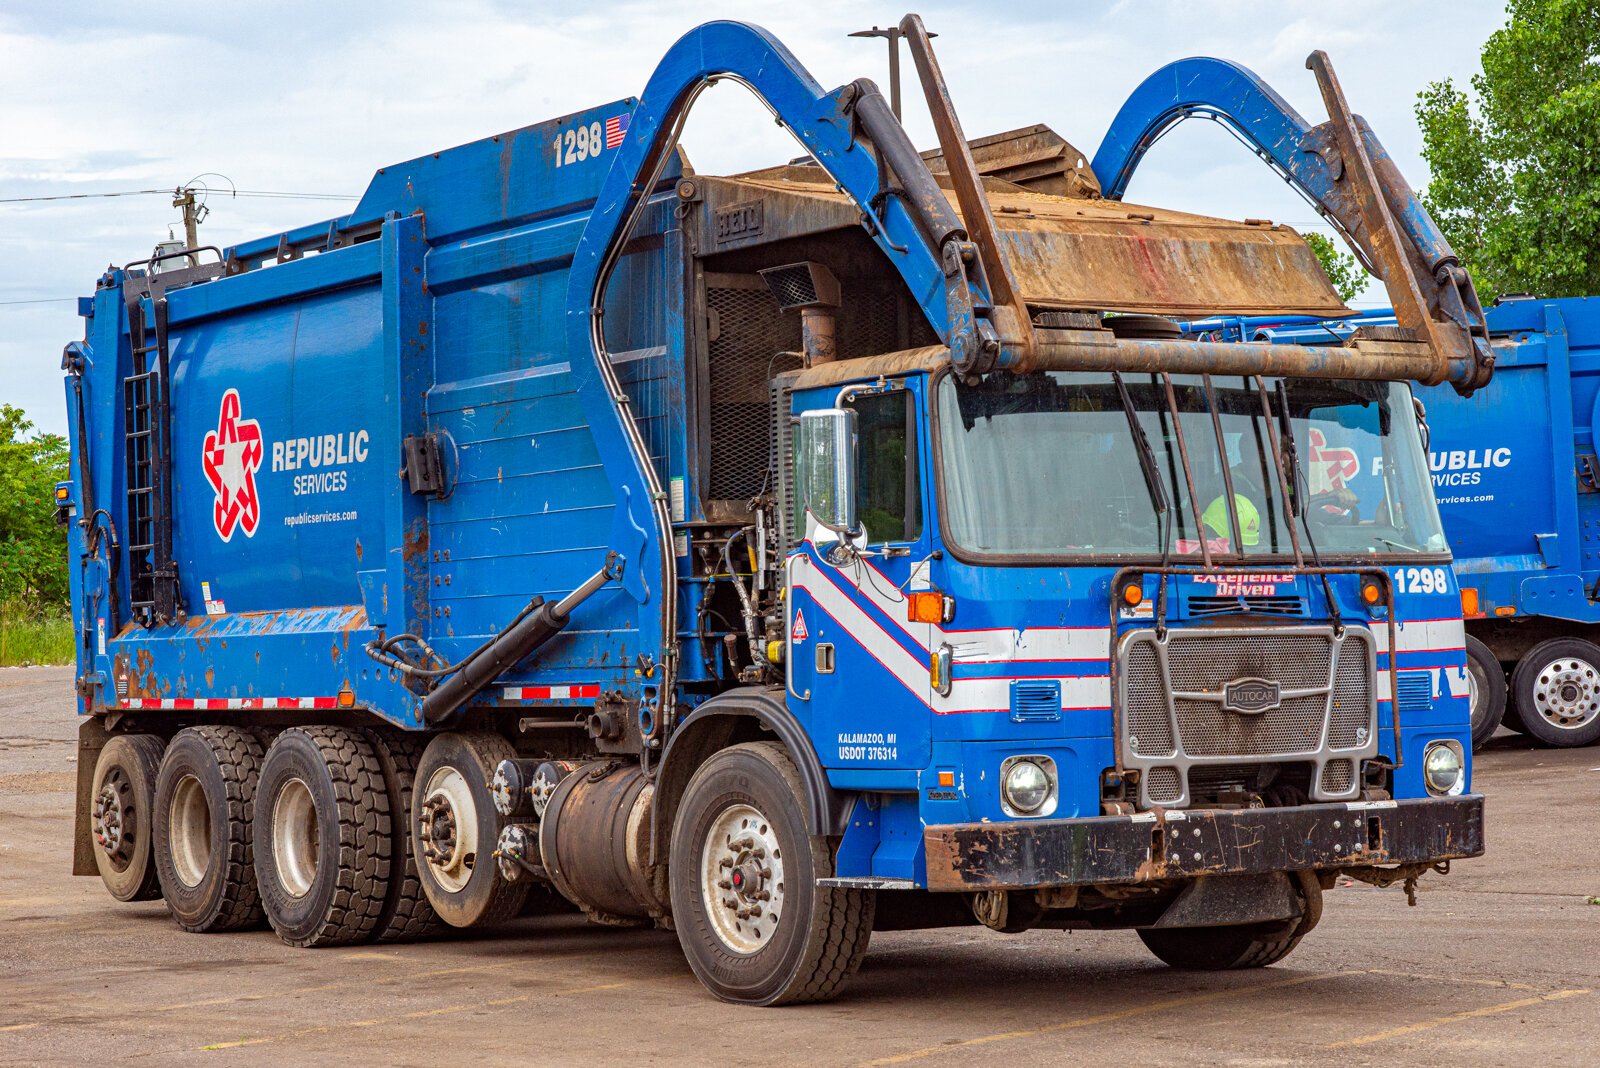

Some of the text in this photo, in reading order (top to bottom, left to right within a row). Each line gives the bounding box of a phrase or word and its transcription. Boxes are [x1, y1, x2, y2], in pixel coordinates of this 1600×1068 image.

[553, 121, 602, 168] 1298
[715, 207, 760, 238] HEIL
[272, 429, 369, 473] REPUBLIC
[293, 470, 347, 496] SERVICES
[284, 510, 358, 528] republicservices.com
[1215, 582, 1276, 596] Driven
[1394, 567, 1447, 594] 1298
[1231, 690, 1274, 702] AUTOCAR
[838, 733, 897, 745] KALAMAZOO, MI
[838, 746, 898, 760] USDOT 376314
